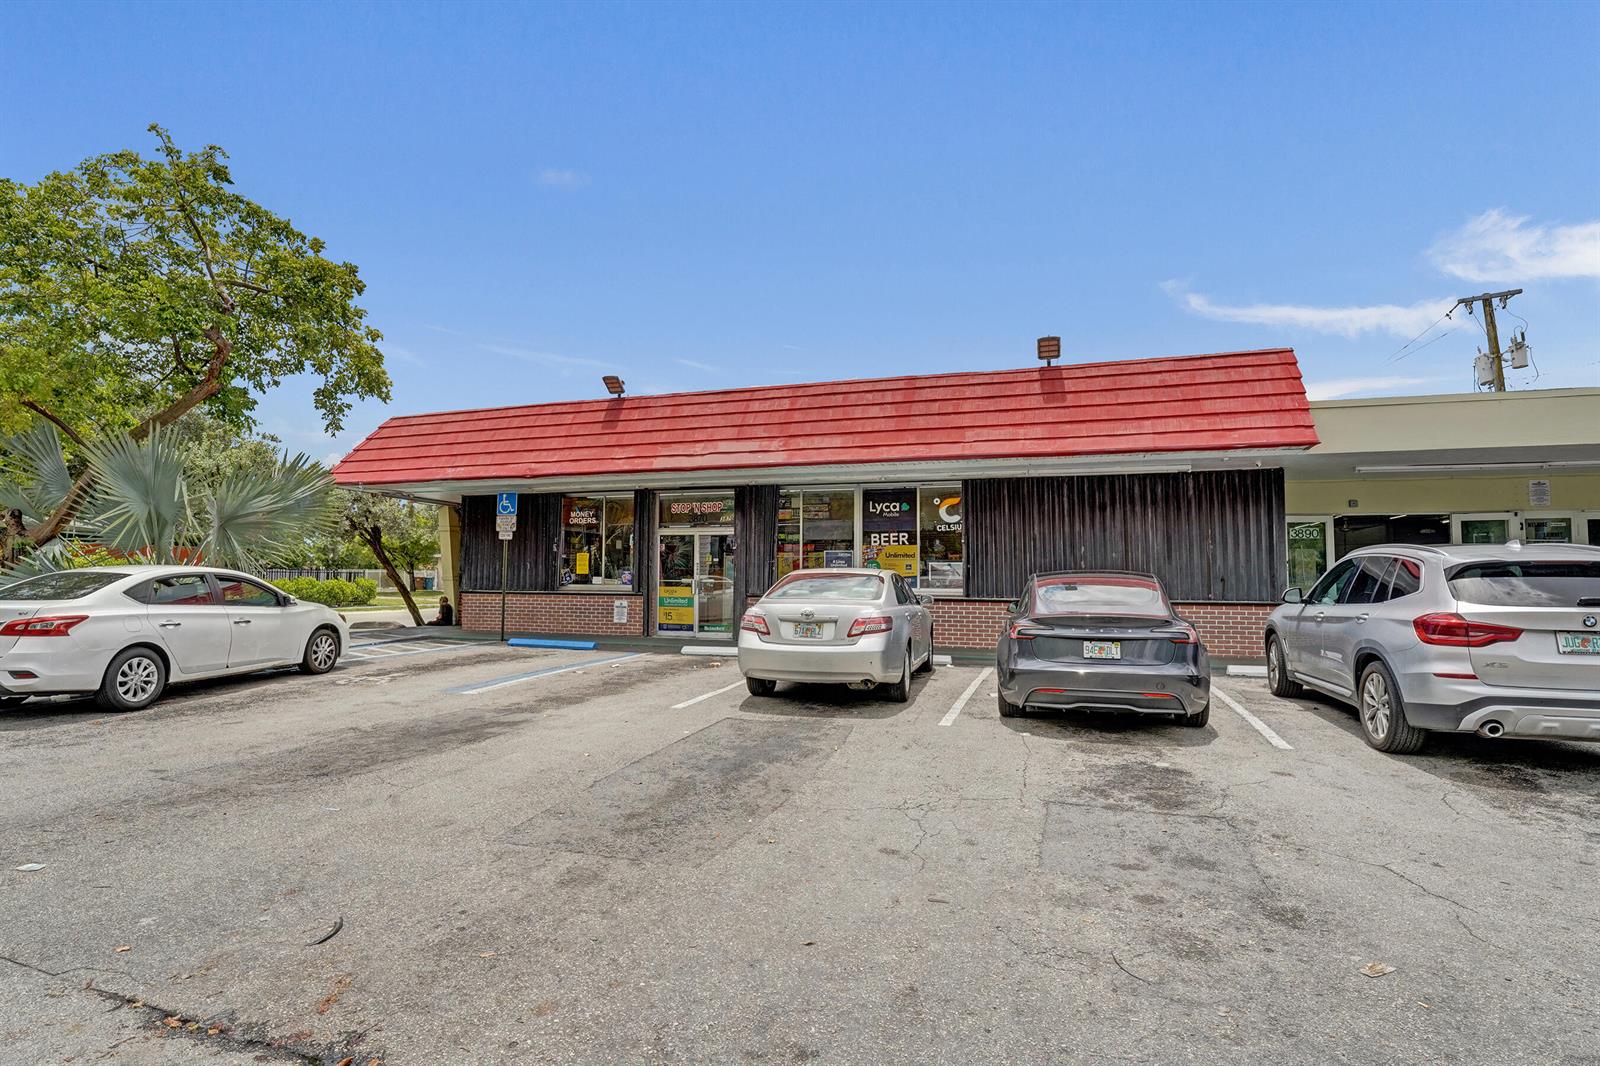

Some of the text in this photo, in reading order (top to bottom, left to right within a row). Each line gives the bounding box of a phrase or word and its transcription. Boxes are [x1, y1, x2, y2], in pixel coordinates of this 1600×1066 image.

[671, 502, 692, 513] STOP
[701, 502, 723, 513] SHOP
[869, 501, 900, 514] Lyca
[936, 524, 962, 532] CELSIU
[1290, 528, 1319, 539] 3890
[870, 533, 909, 546] BEER
